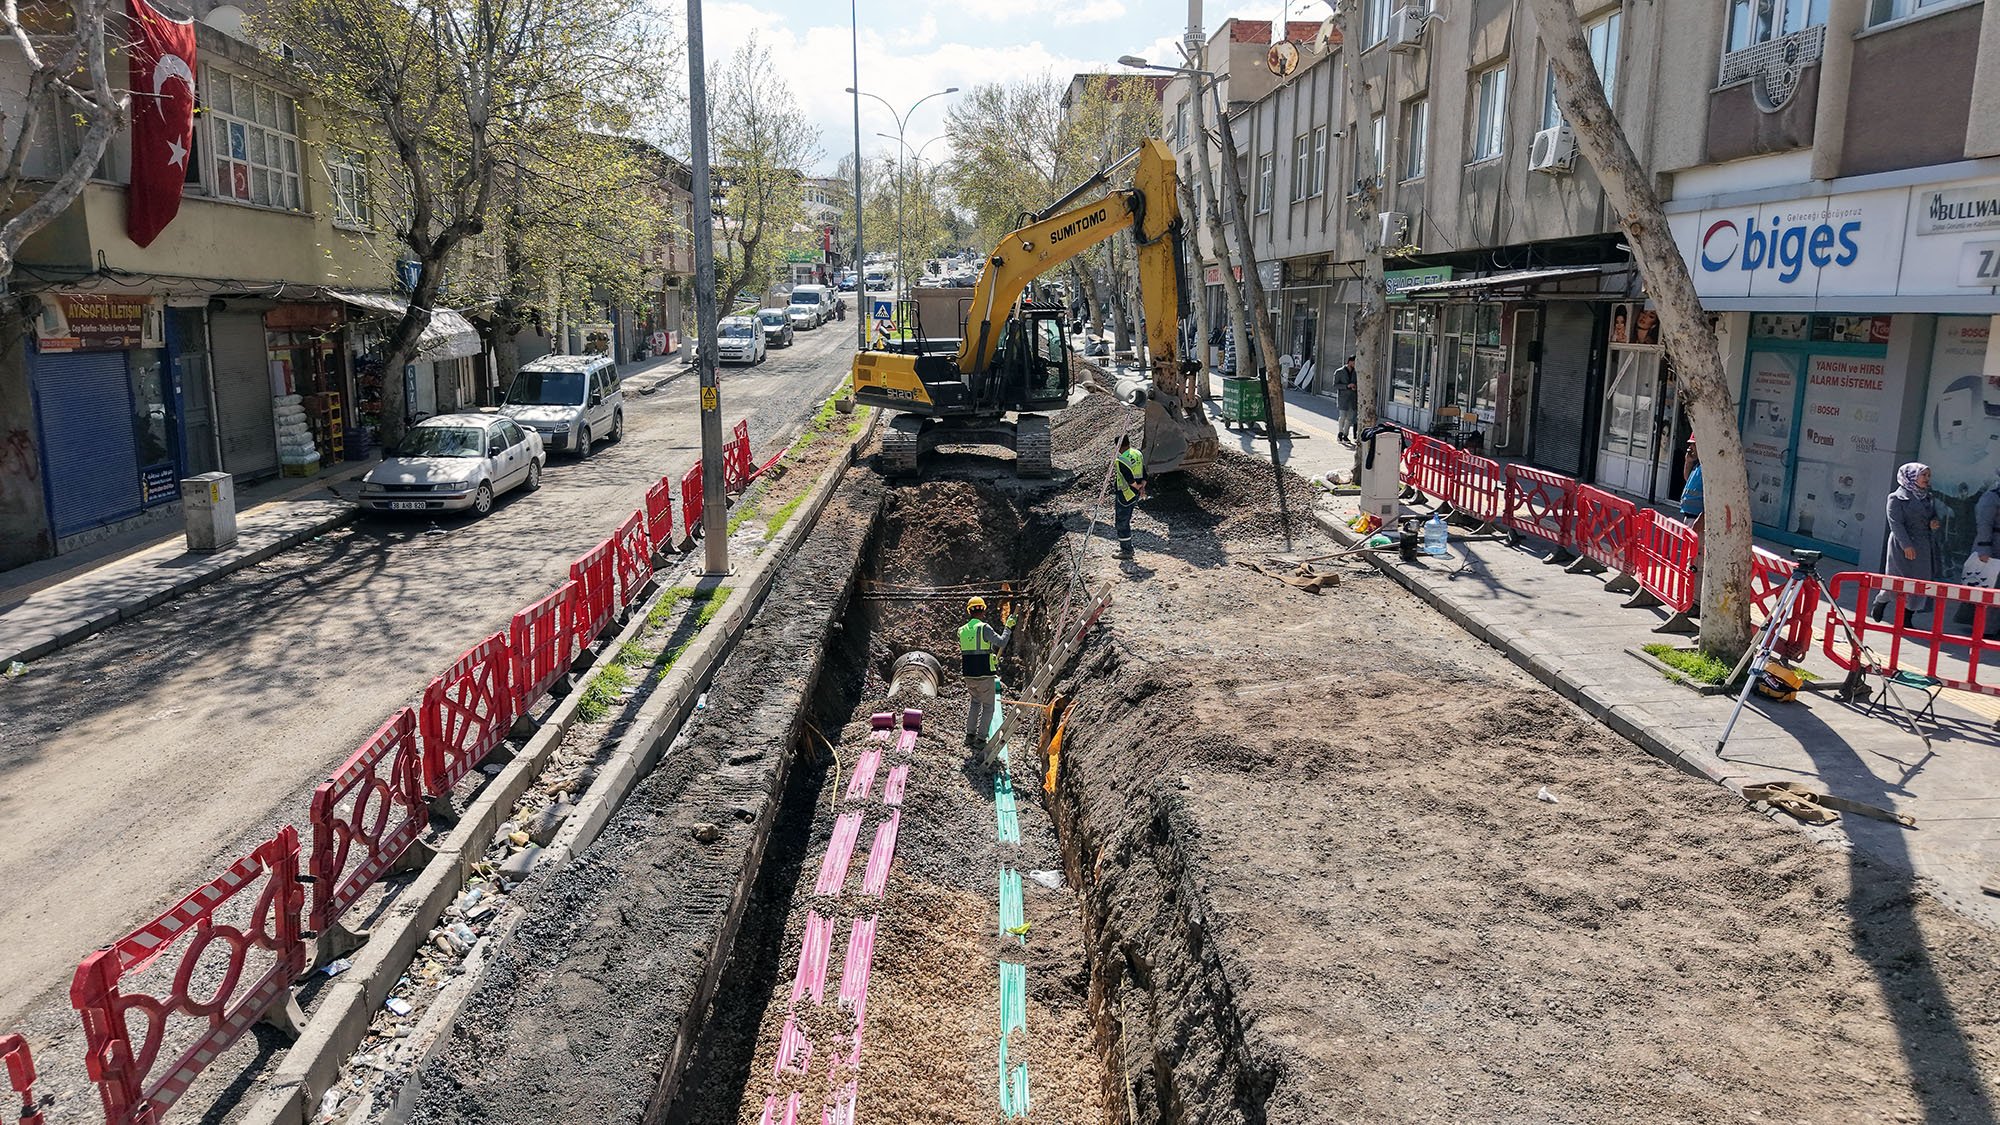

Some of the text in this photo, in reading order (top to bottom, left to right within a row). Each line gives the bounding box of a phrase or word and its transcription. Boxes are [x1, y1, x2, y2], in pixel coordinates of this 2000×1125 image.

[1937, 199, 2000, 221] BULLWA
[1050, 208, 1107, 245] SUMITOMO
[1741, 215, 1861, 284] biges
[68, 304, 109, 319] AYASOFYA
[1816, 361, 1848, 373] YANGIN
[1849, 365, 1858, 373] ve
[1810, 375, 1839, 386] ALARM
[886, 388, 913, 399] SH210
[1817, 405, 1840, 416] BOSCH
